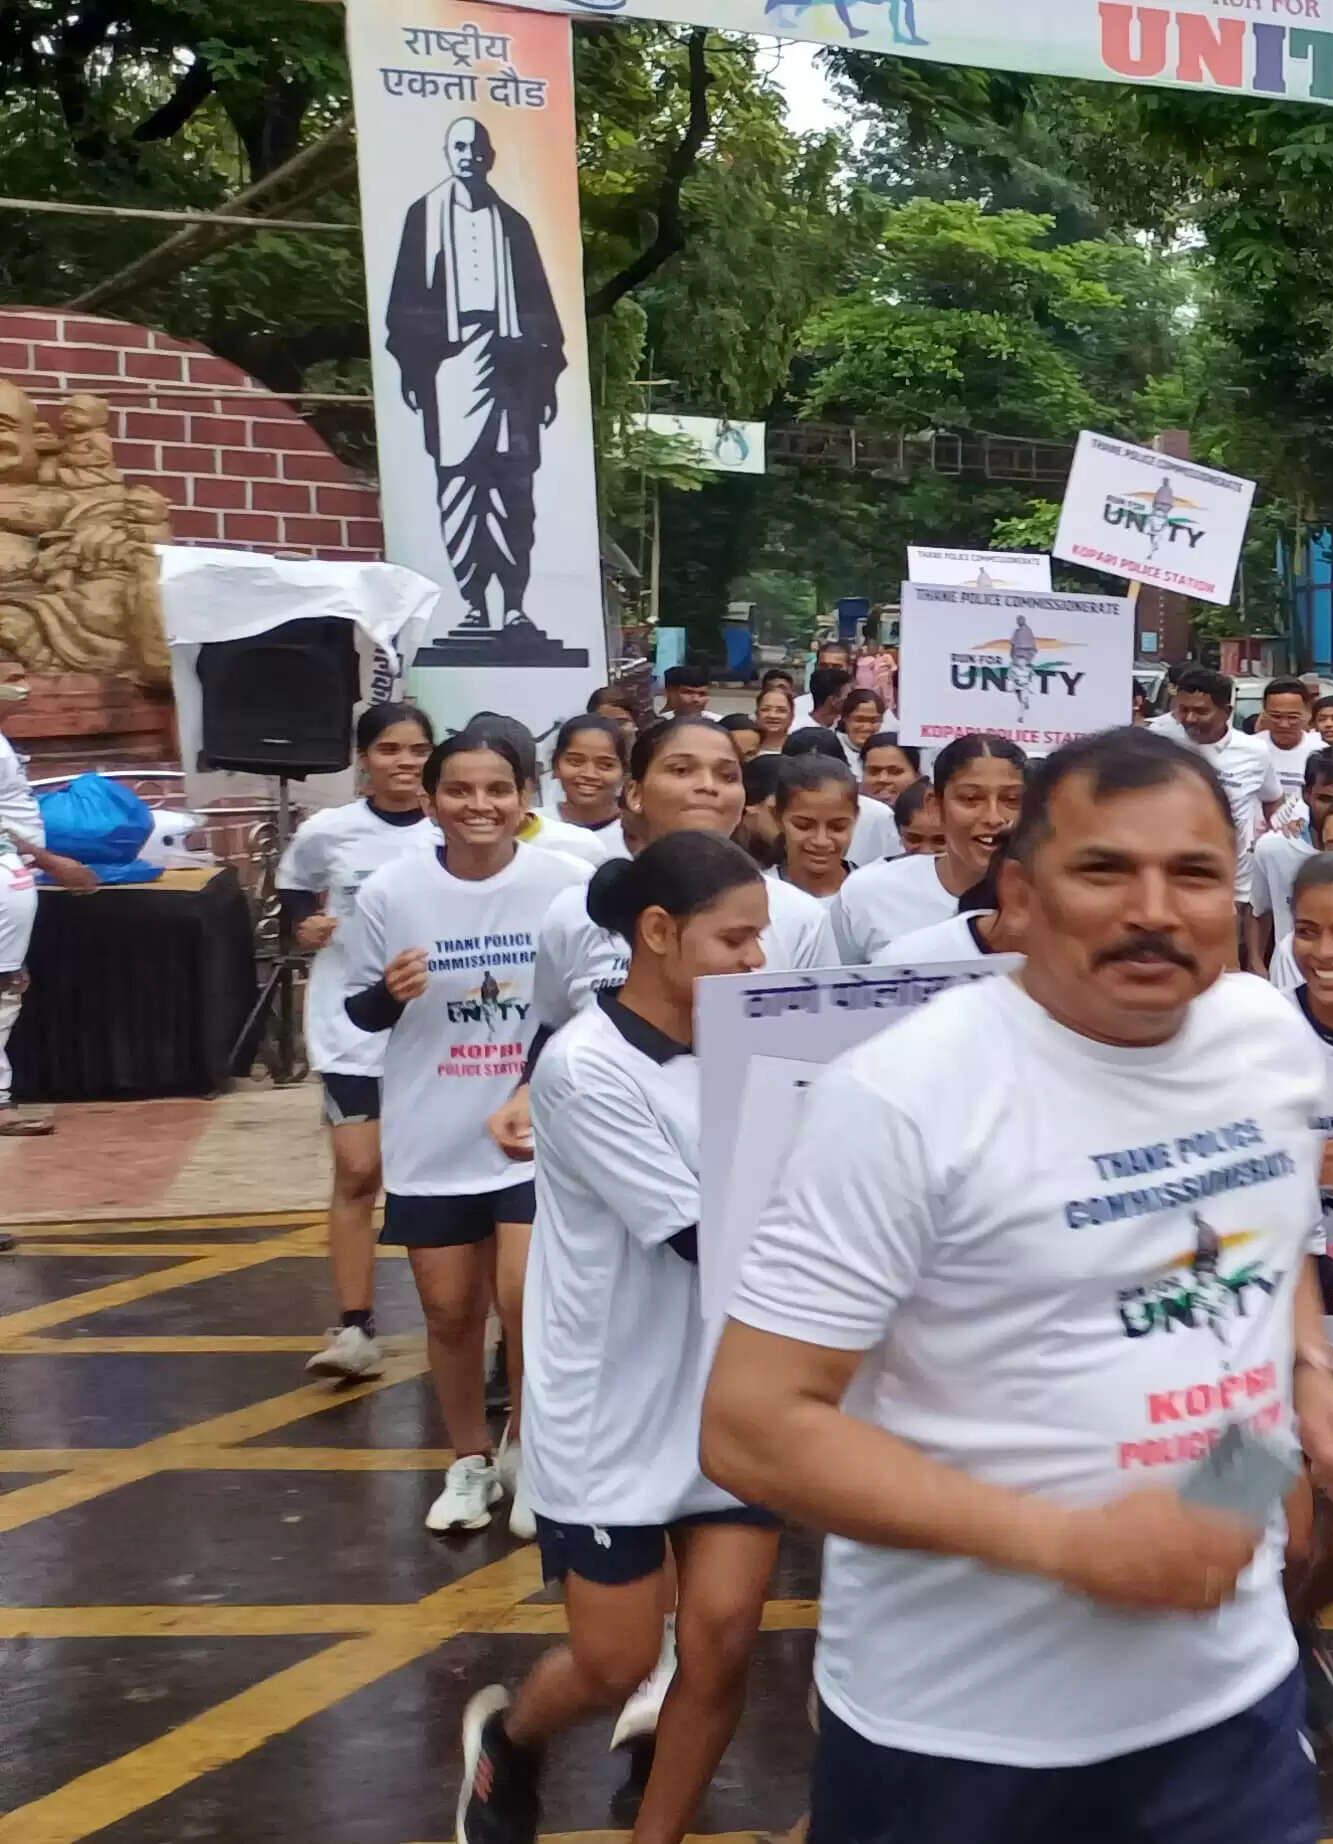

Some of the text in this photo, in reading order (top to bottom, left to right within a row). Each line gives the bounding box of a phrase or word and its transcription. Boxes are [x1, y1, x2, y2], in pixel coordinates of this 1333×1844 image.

[401, 24, 512, 67] राष्ट्रीय
[379, 66, 547, 107] एकता दौड
[1120, 557, 1161, 580] POLICE
[1164, 570, 1216, 594] STATION
[914, 588, 1121, 616] THANE POLICE COMMISSIONERATE
[951, 653, 1003, 665] RUN FOR
[434, 931, 533, 954] THANE POLICE
[438, 1062, 481, 1078] POLICE
